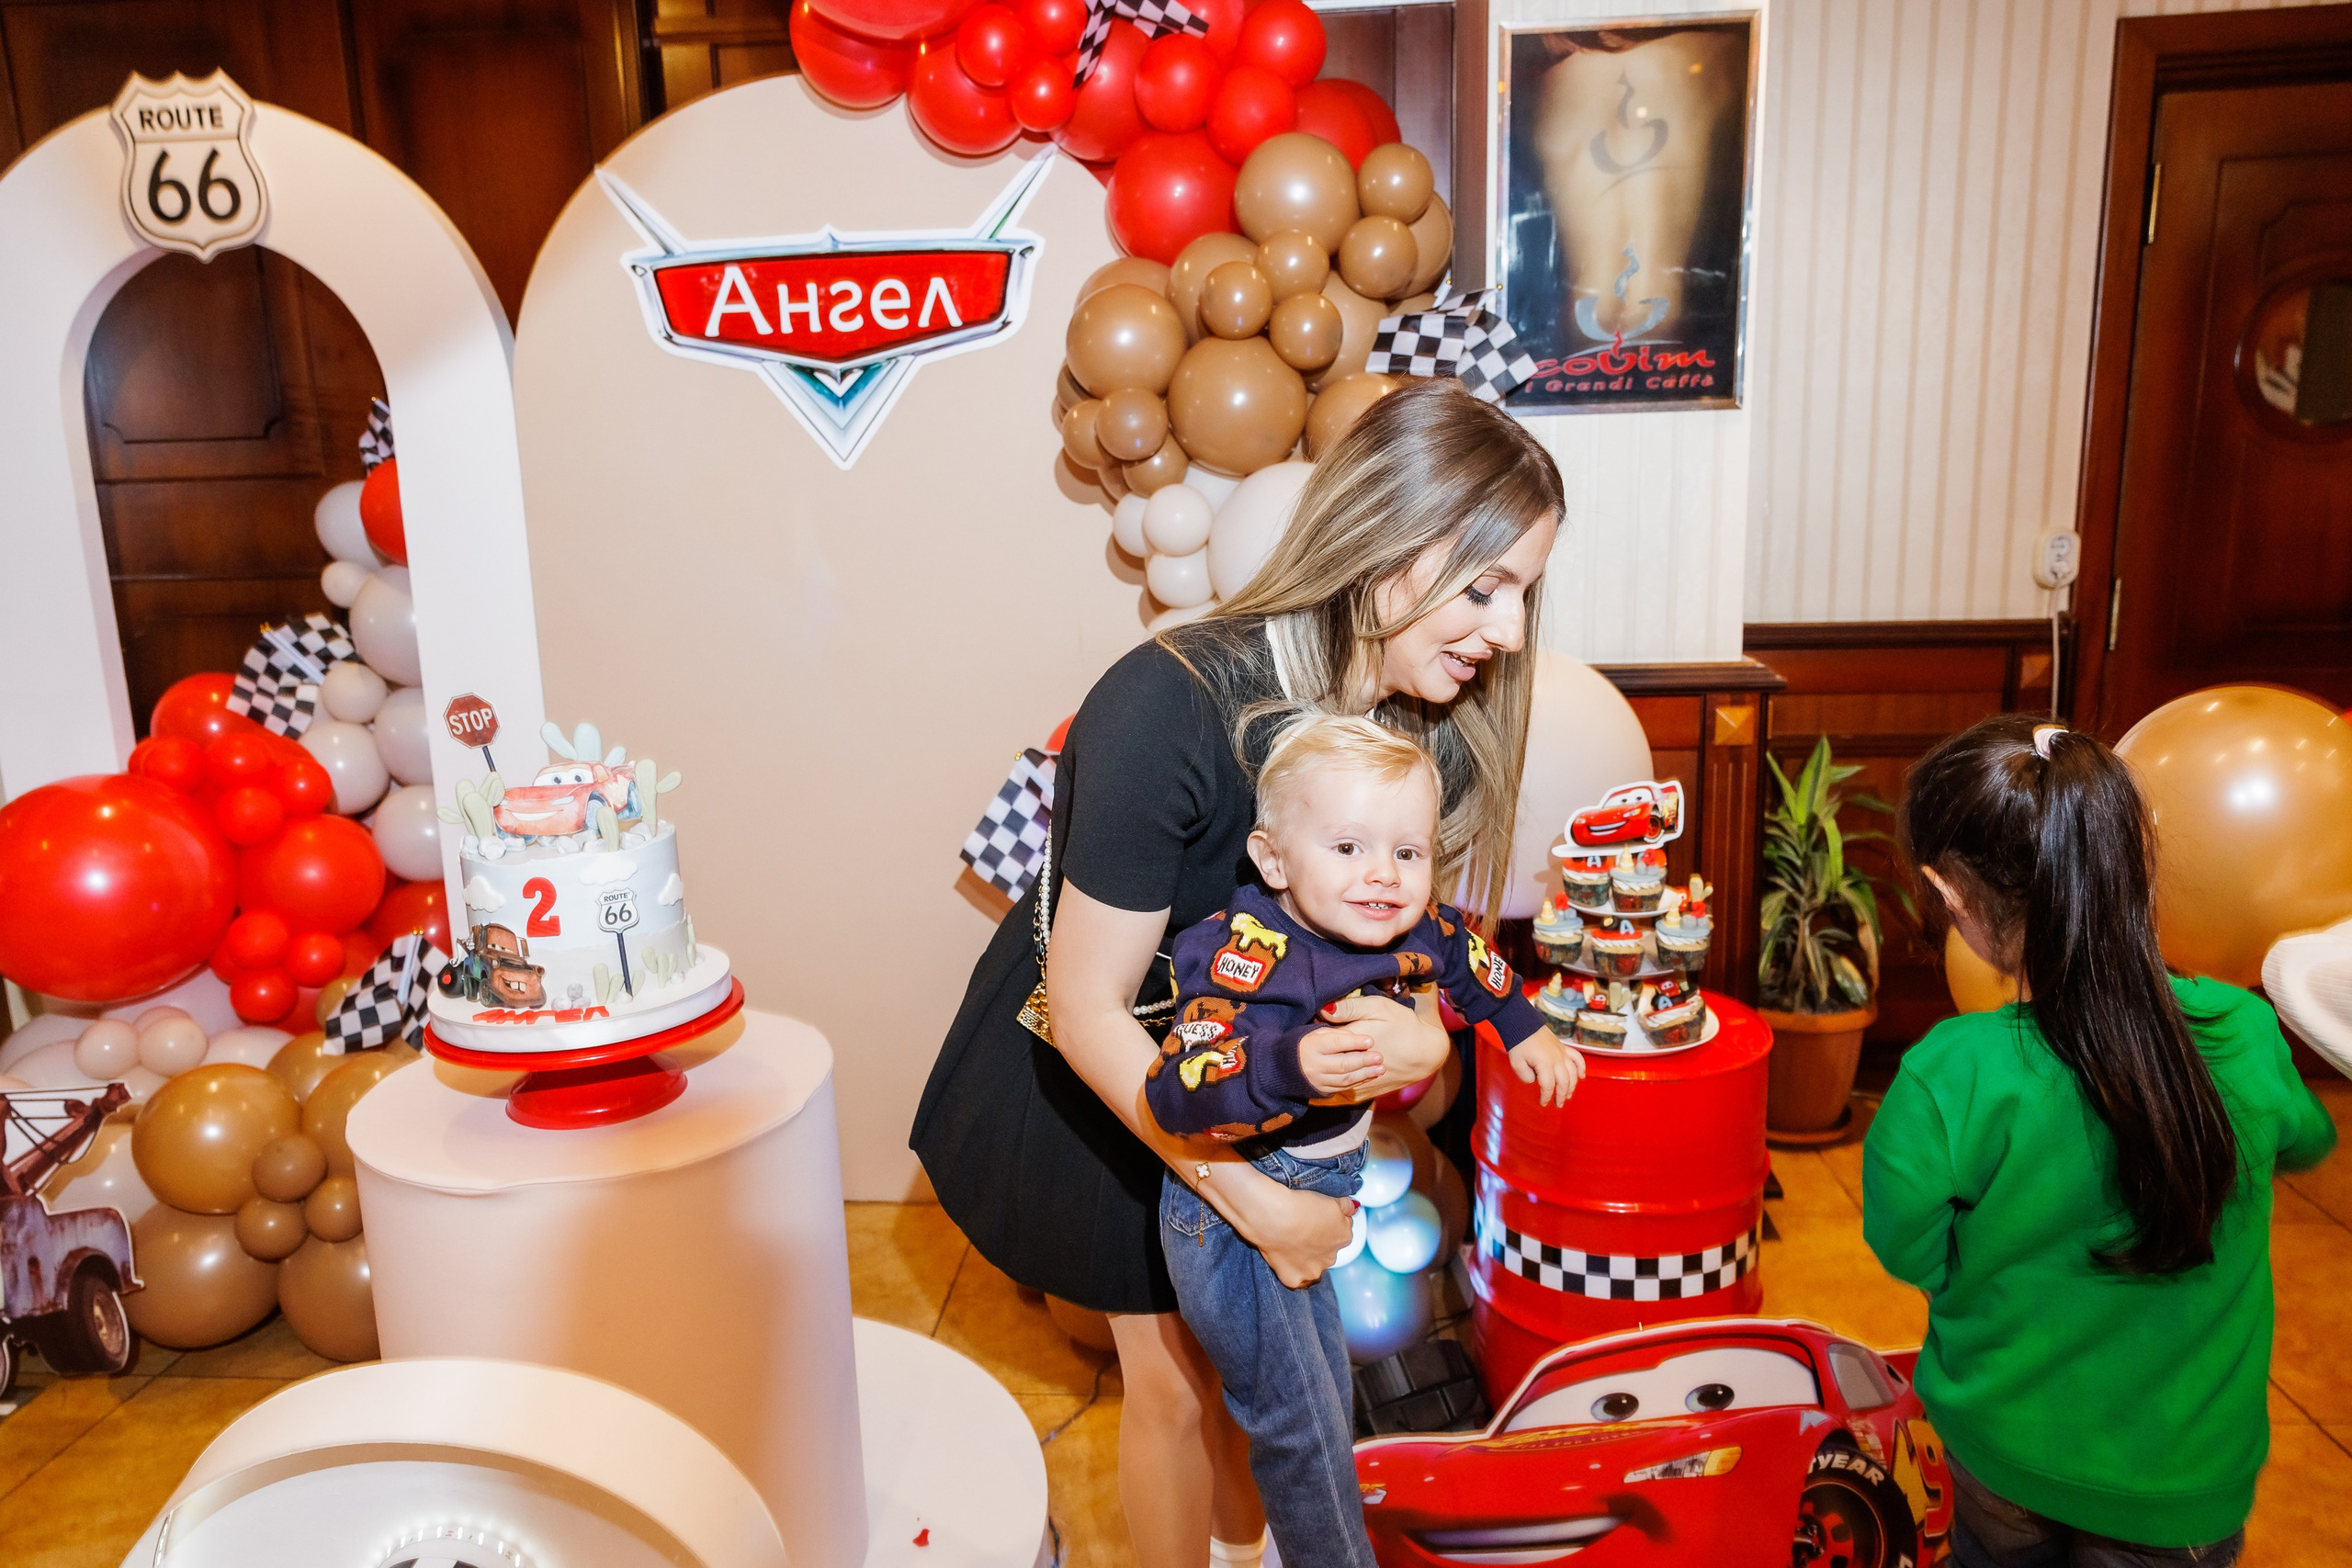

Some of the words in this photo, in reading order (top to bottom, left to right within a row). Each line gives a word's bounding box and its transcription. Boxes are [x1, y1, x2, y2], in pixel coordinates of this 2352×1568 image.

[139, 105, 223, 132] ROUTE
[148, 148, 242, 226] 66
[704, 265, 964, 337] Ангел
[1545, 376, 1634, 393] Grandi
[448, 707, 493, 736] STOP
[522, 876, 561, 938] 2
[604, 891, 628, 903] ROUTE
[605, 903, 632, 926] 66
[1217, 956, 1261, 979] HONEY
[1176, 1023, 1218, 1040] GUESS
